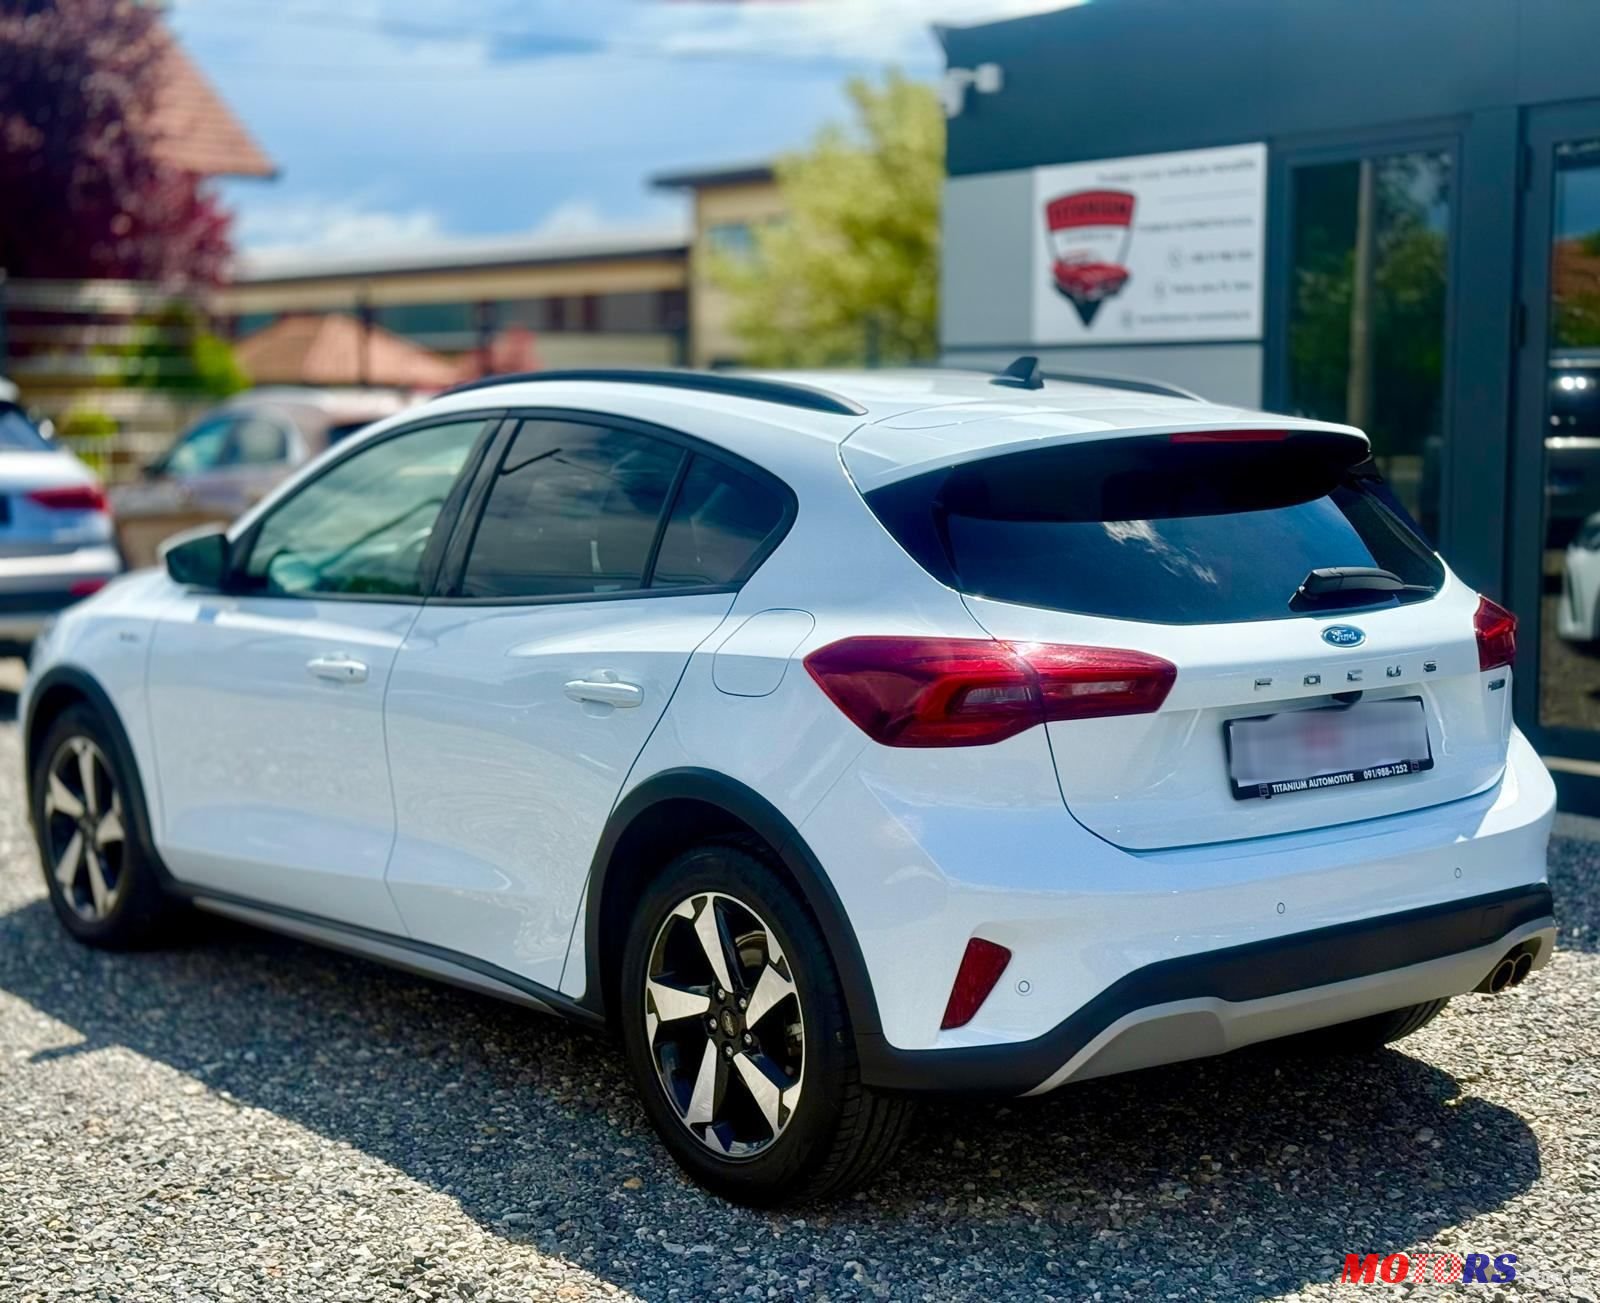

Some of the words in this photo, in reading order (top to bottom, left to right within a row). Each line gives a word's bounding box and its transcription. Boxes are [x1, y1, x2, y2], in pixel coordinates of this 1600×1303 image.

[1254, 660, 1438, 691] FOCUS
[1272, 781, 1308, 794] TITANIUM
[1308, 773, 1355, 788] AUTOMOTIVE
